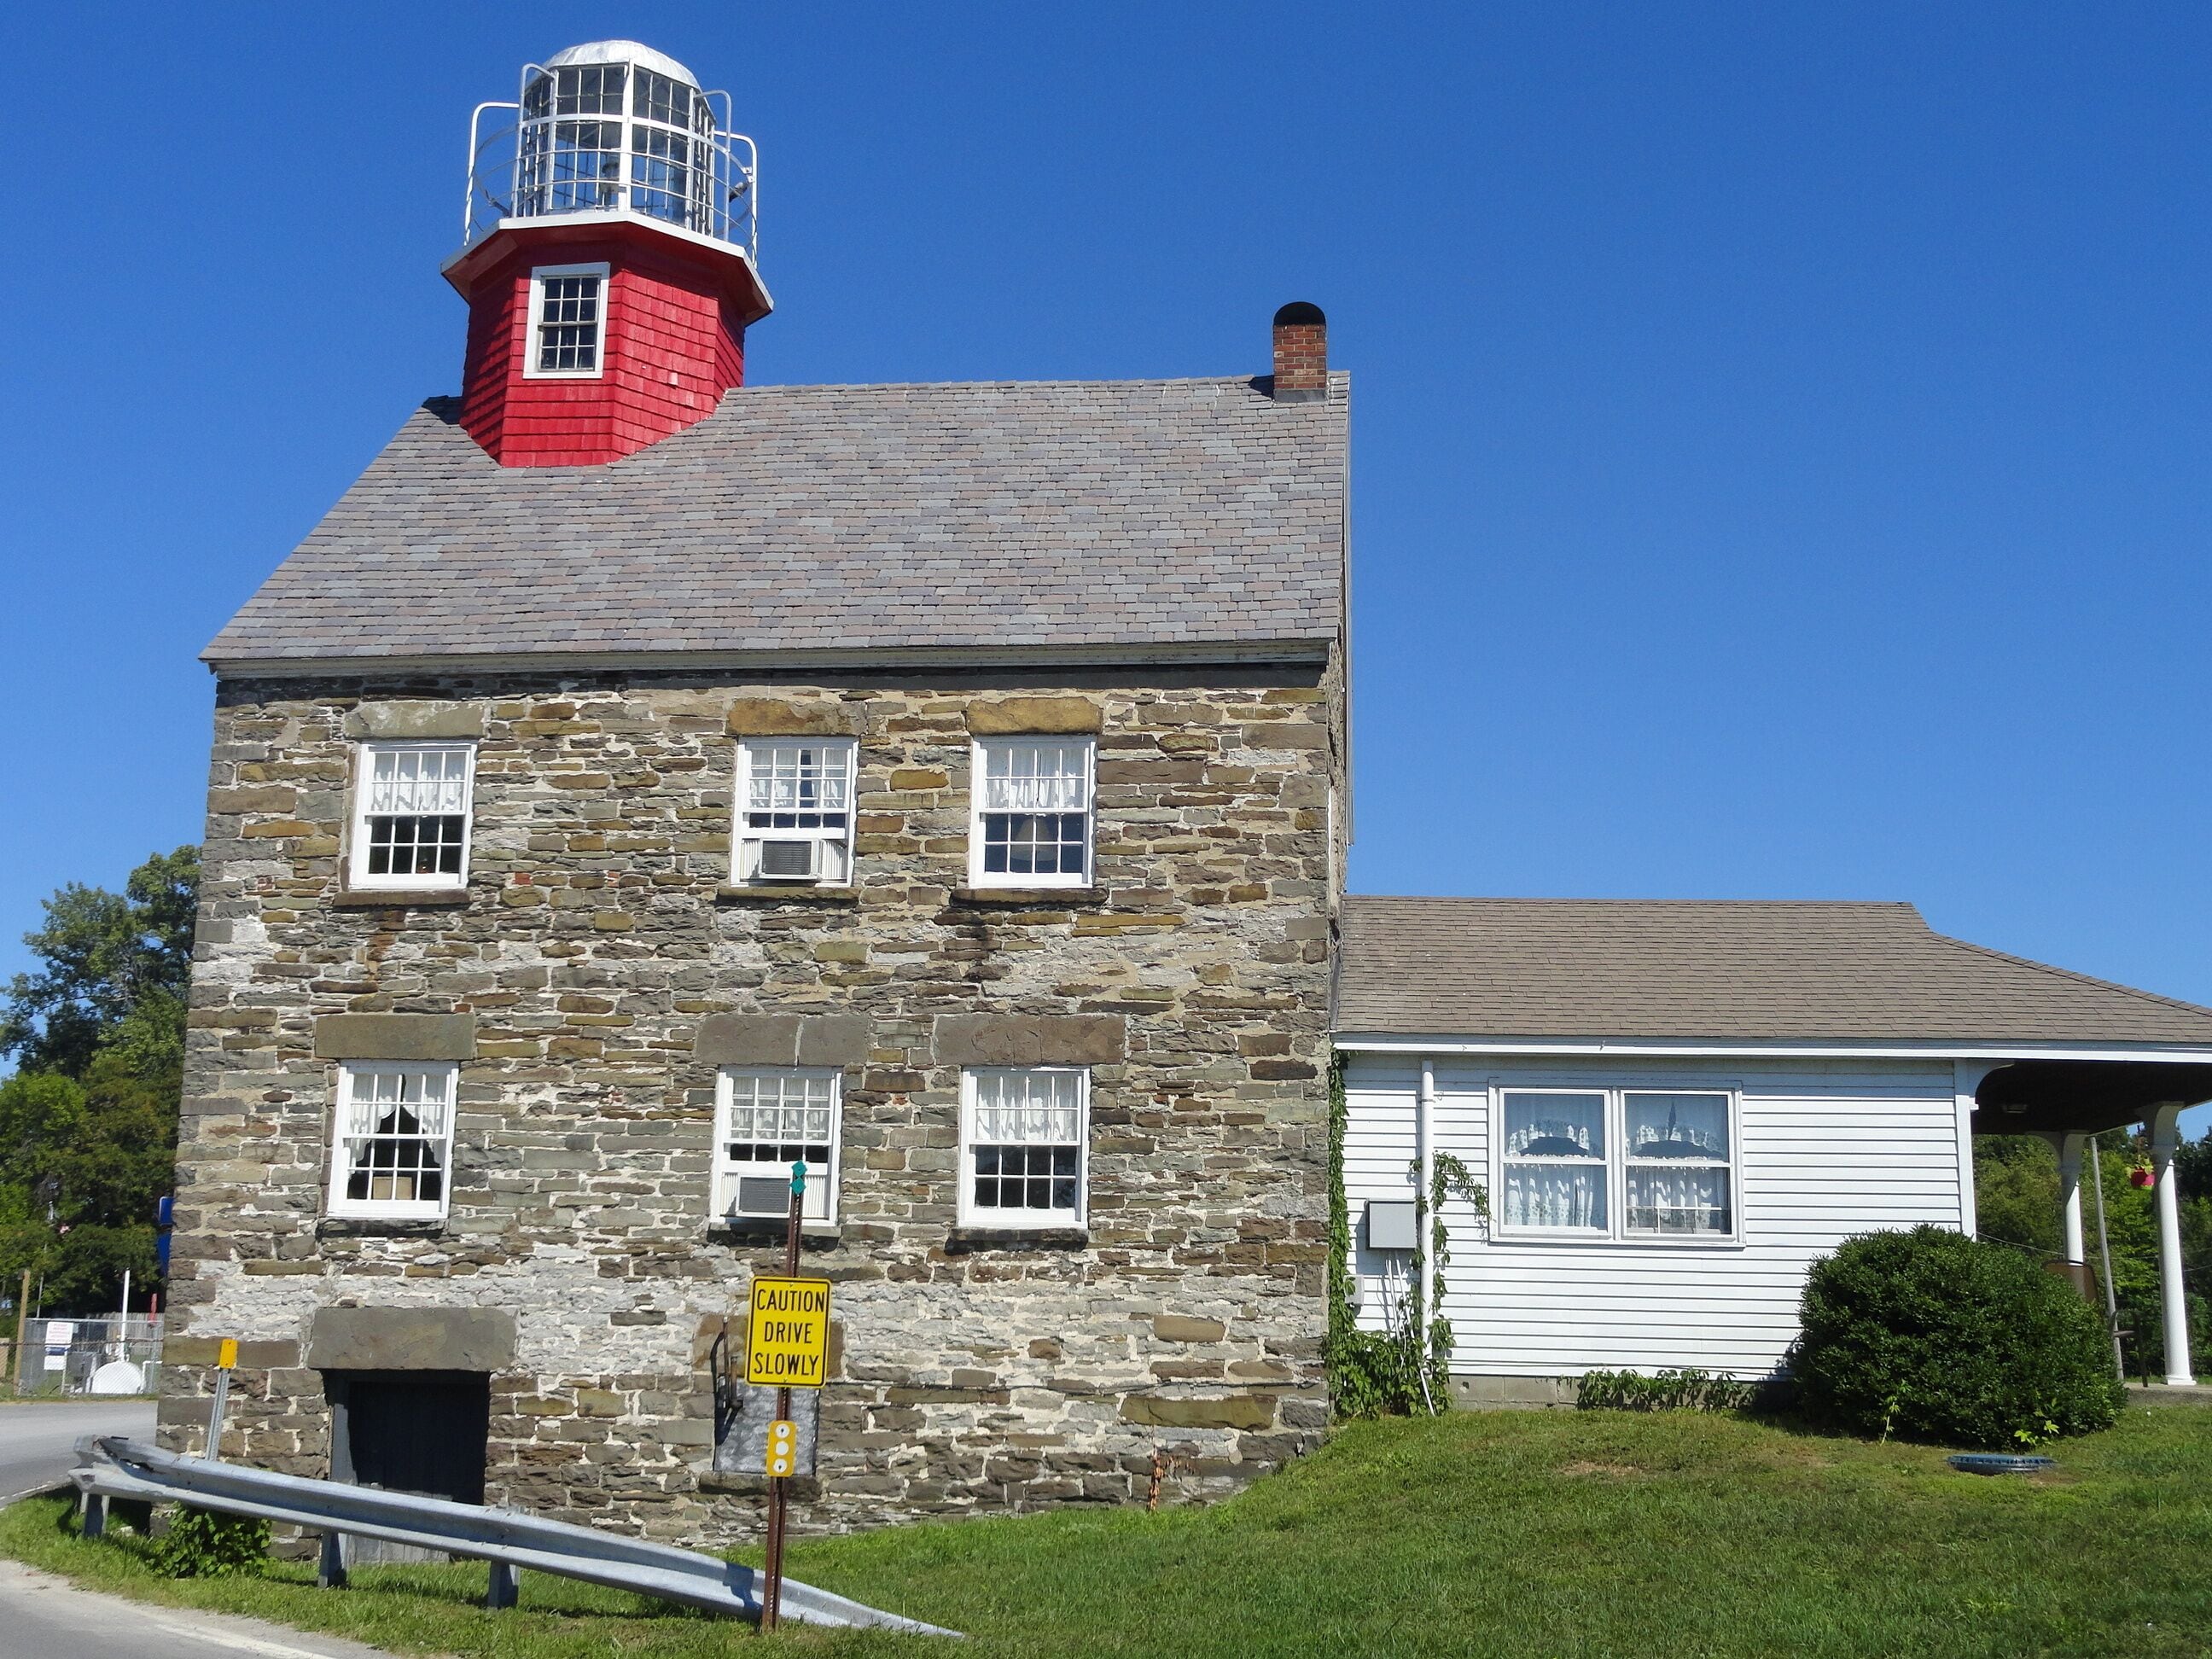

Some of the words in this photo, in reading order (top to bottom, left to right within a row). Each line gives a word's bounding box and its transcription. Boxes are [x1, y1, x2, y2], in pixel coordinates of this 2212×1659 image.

[757, 1289, 825, 1313] CAUTION
[764, 1321, 813, 1344] DRIVE
[754, 1352, 819, 1376] SLOWLY
